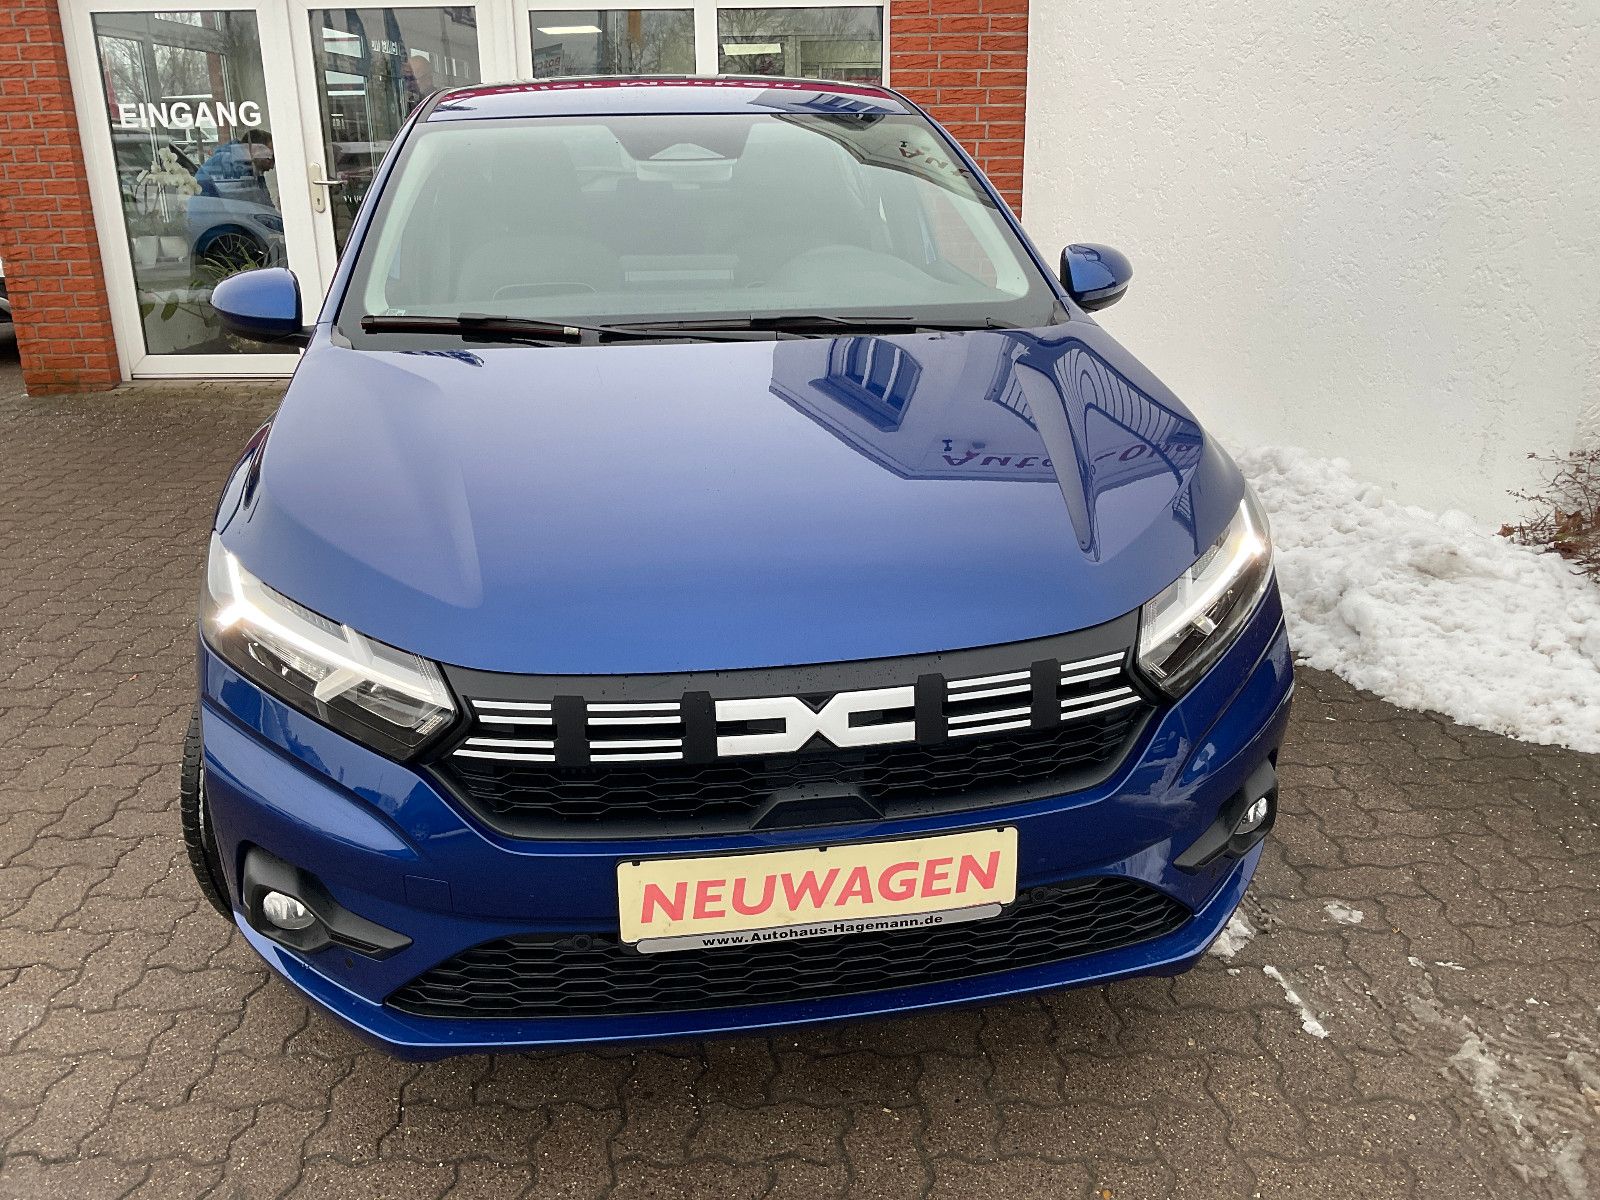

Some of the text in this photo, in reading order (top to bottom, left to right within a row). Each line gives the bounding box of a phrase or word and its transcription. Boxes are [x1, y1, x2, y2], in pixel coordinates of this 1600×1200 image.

[118, 101, 262, 128] EINGANG
[640, 850, 1000, 923] NEUWAGEN
[702, 914, 943, 946] www.Autohaus-Hagemann.de
